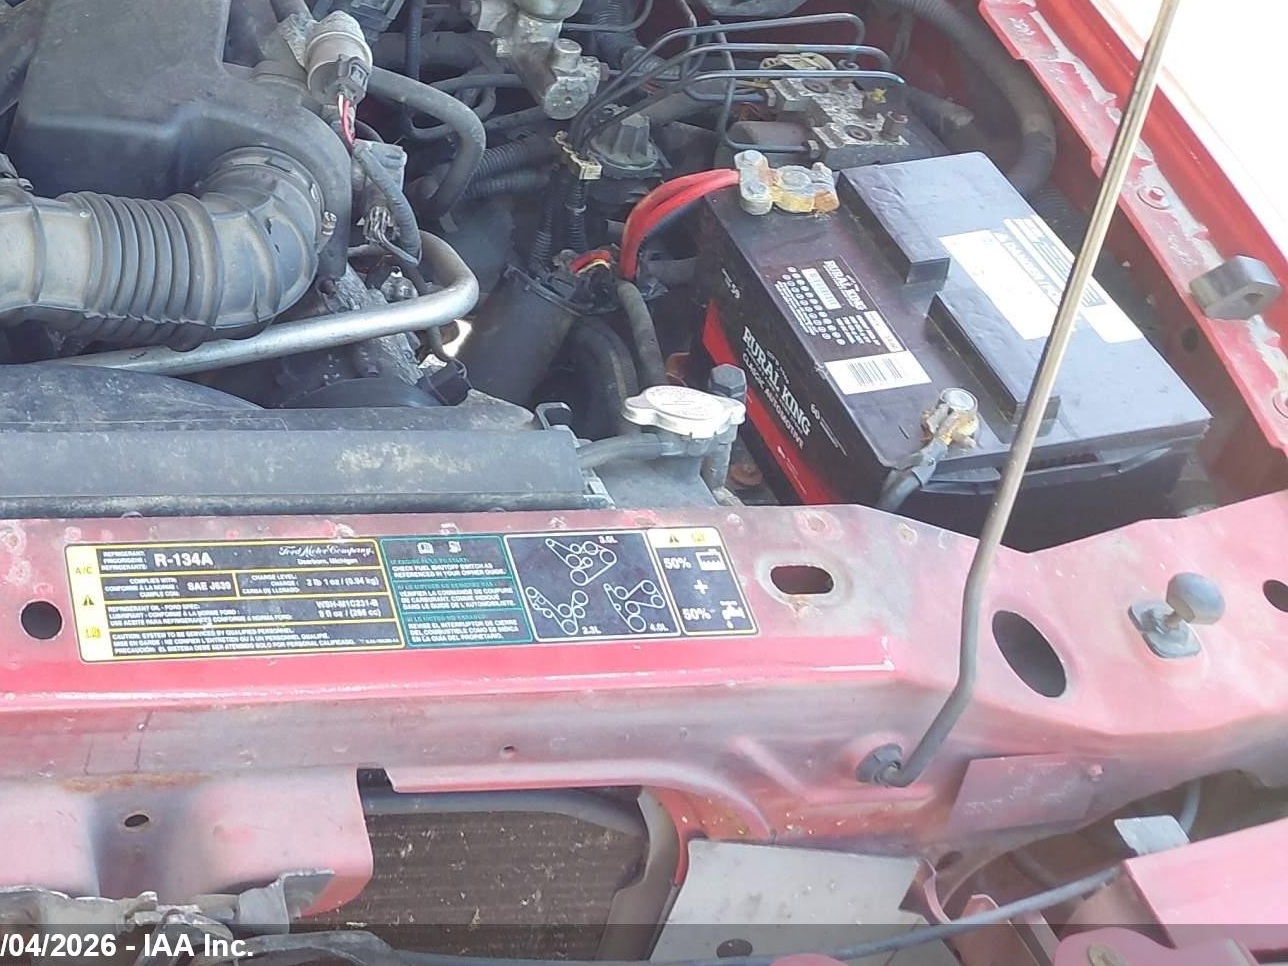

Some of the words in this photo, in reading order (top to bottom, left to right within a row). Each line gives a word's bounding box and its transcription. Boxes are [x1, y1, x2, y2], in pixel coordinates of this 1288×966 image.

[823, 260, 855, 289] RURAL
[843, 288, 868, 311] KING
[743, 326, 780, 392] RURAL
[781, 384, 811, 436] KING
[764, 388, 804, 450] AUTOMOTIVE
[299, 545, 328, 559] Motor
[153, 552, 214, 568] R-134A
[663, 557, 692, 570] 50%
[186, 582, 208, 591] SAE
[682, 608, 712, 621] 50%
[650, 623, 670, 632] 4.0L
